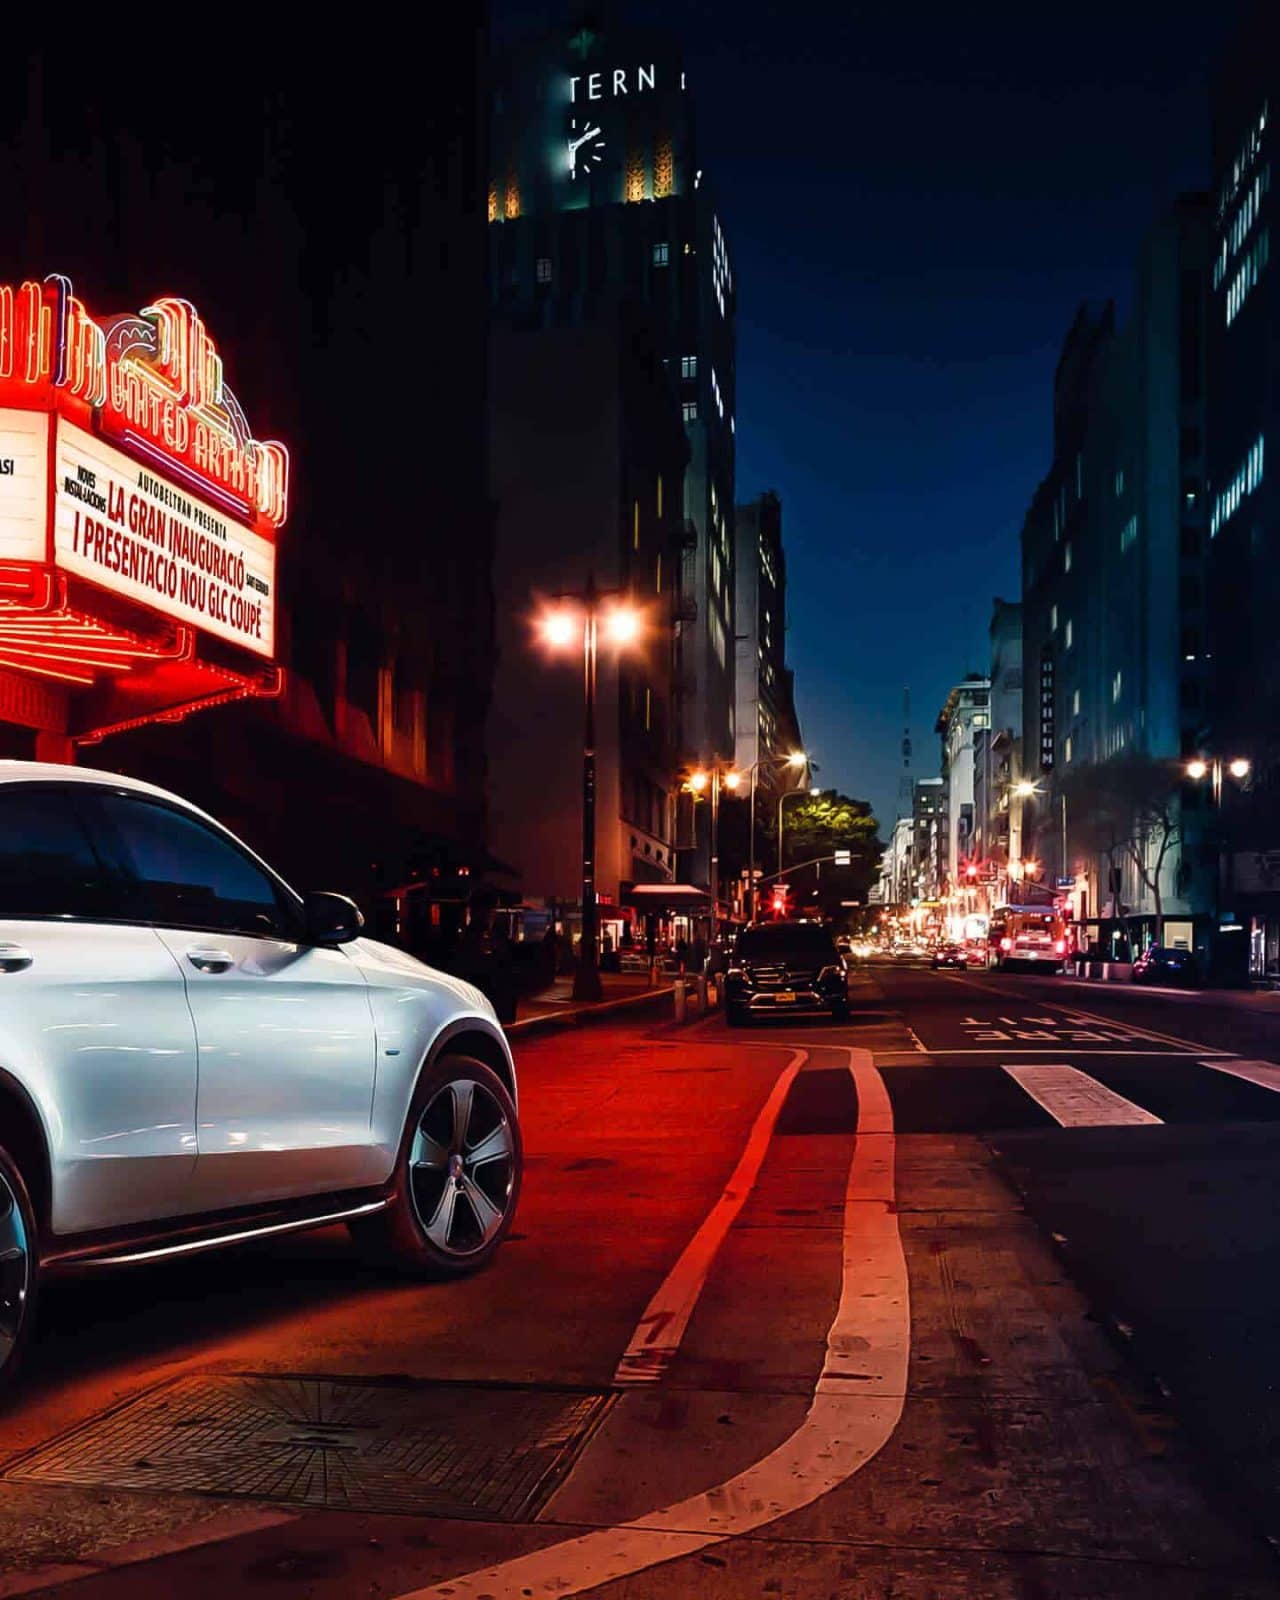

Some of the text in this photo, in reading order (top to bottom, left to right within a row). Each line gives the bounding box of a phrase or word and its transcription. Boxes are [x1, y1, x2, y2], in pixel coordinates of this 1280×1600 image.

[111, 361, 189, 453] UNITED
[108, 480, 245, 591] LA GRAN INAUGURACIÓ
[138, 471, 227, 541] AUTOBELTRAN PRESENTA
[73, 511, 80, 552] I
[180, 567, 207, 612] NOU
[208, 582, 228, 624] GLC
[230, 600, 261, 638] COUPÉ
